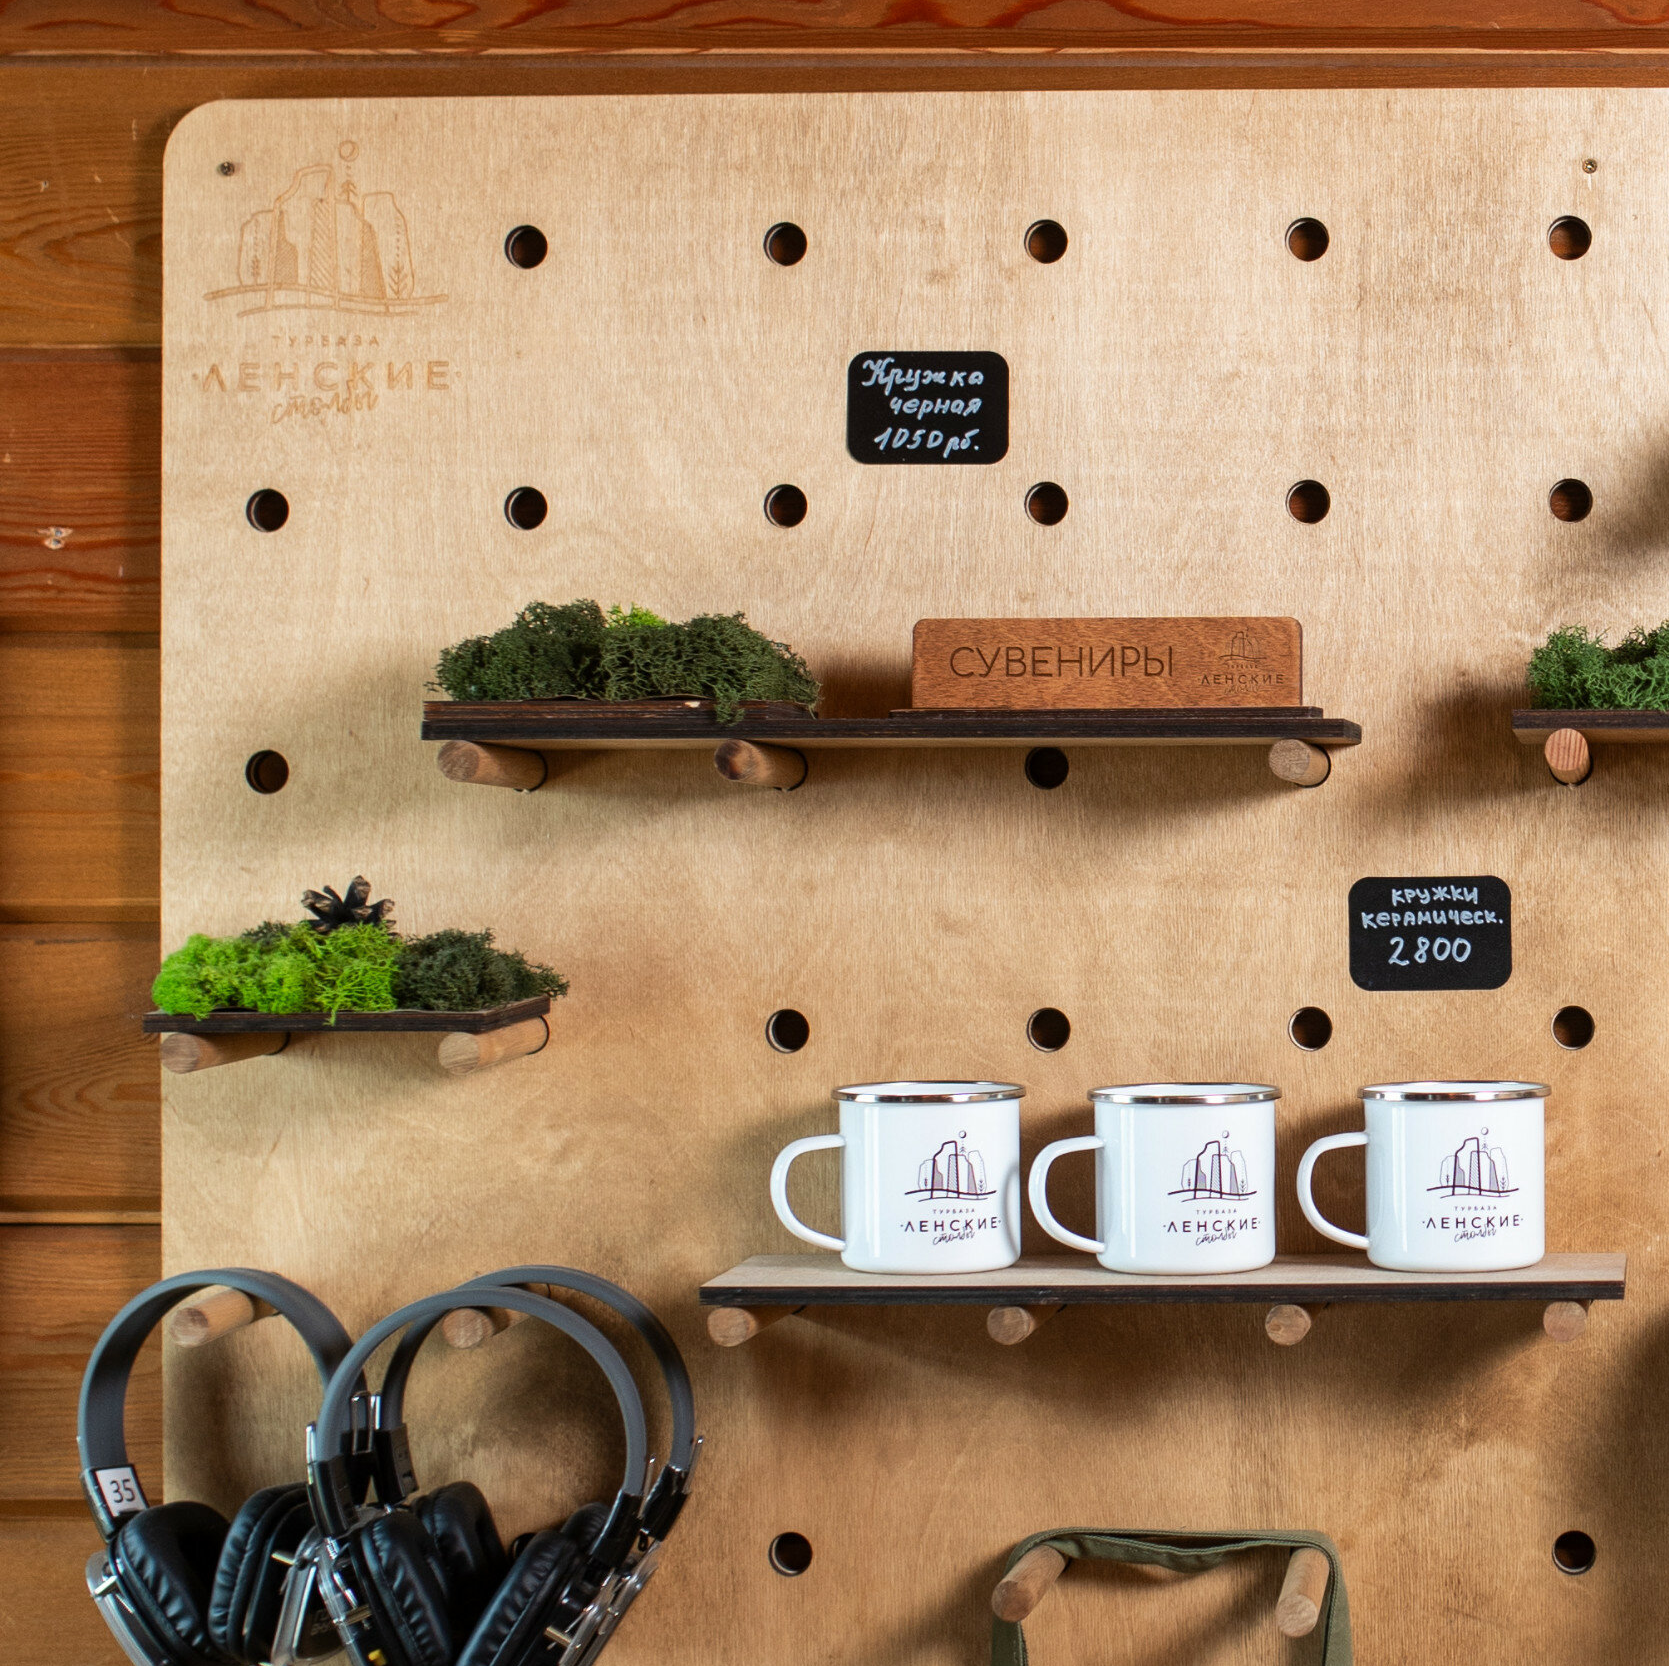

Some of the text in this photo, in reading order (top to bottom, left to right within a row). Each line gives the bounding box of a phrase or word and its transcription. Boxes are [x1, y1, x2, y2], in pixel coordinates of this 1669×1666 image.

[202, 360, 450, 392] ЛЕНСКИЕ
[861, 357, 985, 396] Кружка
[949, 646, 1174, 678] СУВЕНИРЫ
[1201, 674, 1285, 685] ЛЕНСКИЕ
[1388, 936, 1472, 966] 2800
[904, 1216, 998, 1233] ЛЕНСКИЕ
[1167, 1217, 1258, 1233] ЛЕНСКИЕ
[1426, 1214, 1520, 1230] ЛЕНСКИЕ
[110, 1478, 135, 1503] 35
